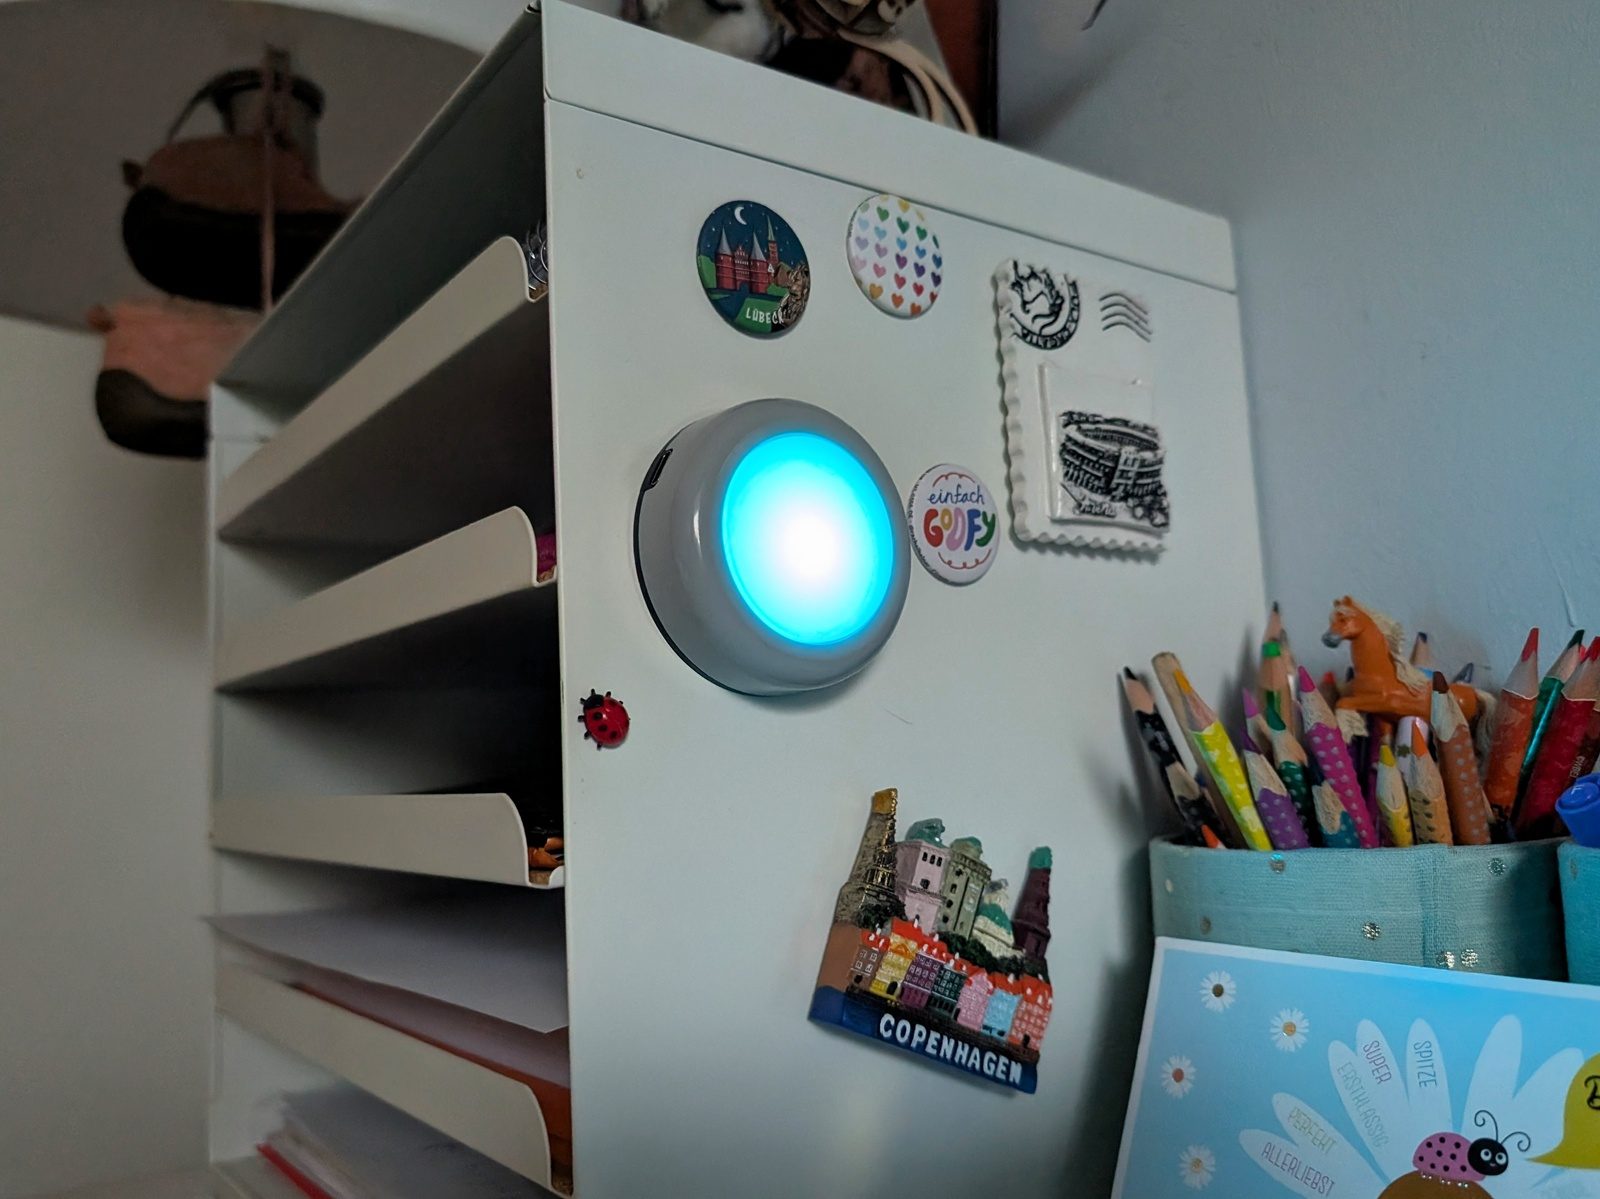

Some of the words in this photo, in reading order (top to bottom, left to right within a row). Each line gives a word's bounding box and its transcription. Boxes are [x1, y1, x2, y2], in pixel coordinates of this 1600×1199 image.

[928, 483, 985, 505] einfach
[923, 507, 996, 552] GOOFY
[879, 1012, 1023, 1086] COPENHAGEN
[1362, 1040, 1393, 1085] SUPER
[1413, 1040, 1438, 1089] SPITZE
[1336, 1060, 1390, 1148] ERSTKLASSIG
[1287, 1105, 1338, 1155] PERFEKT
[1261, 1141, 1336, 1199] ALLERLIEBST
